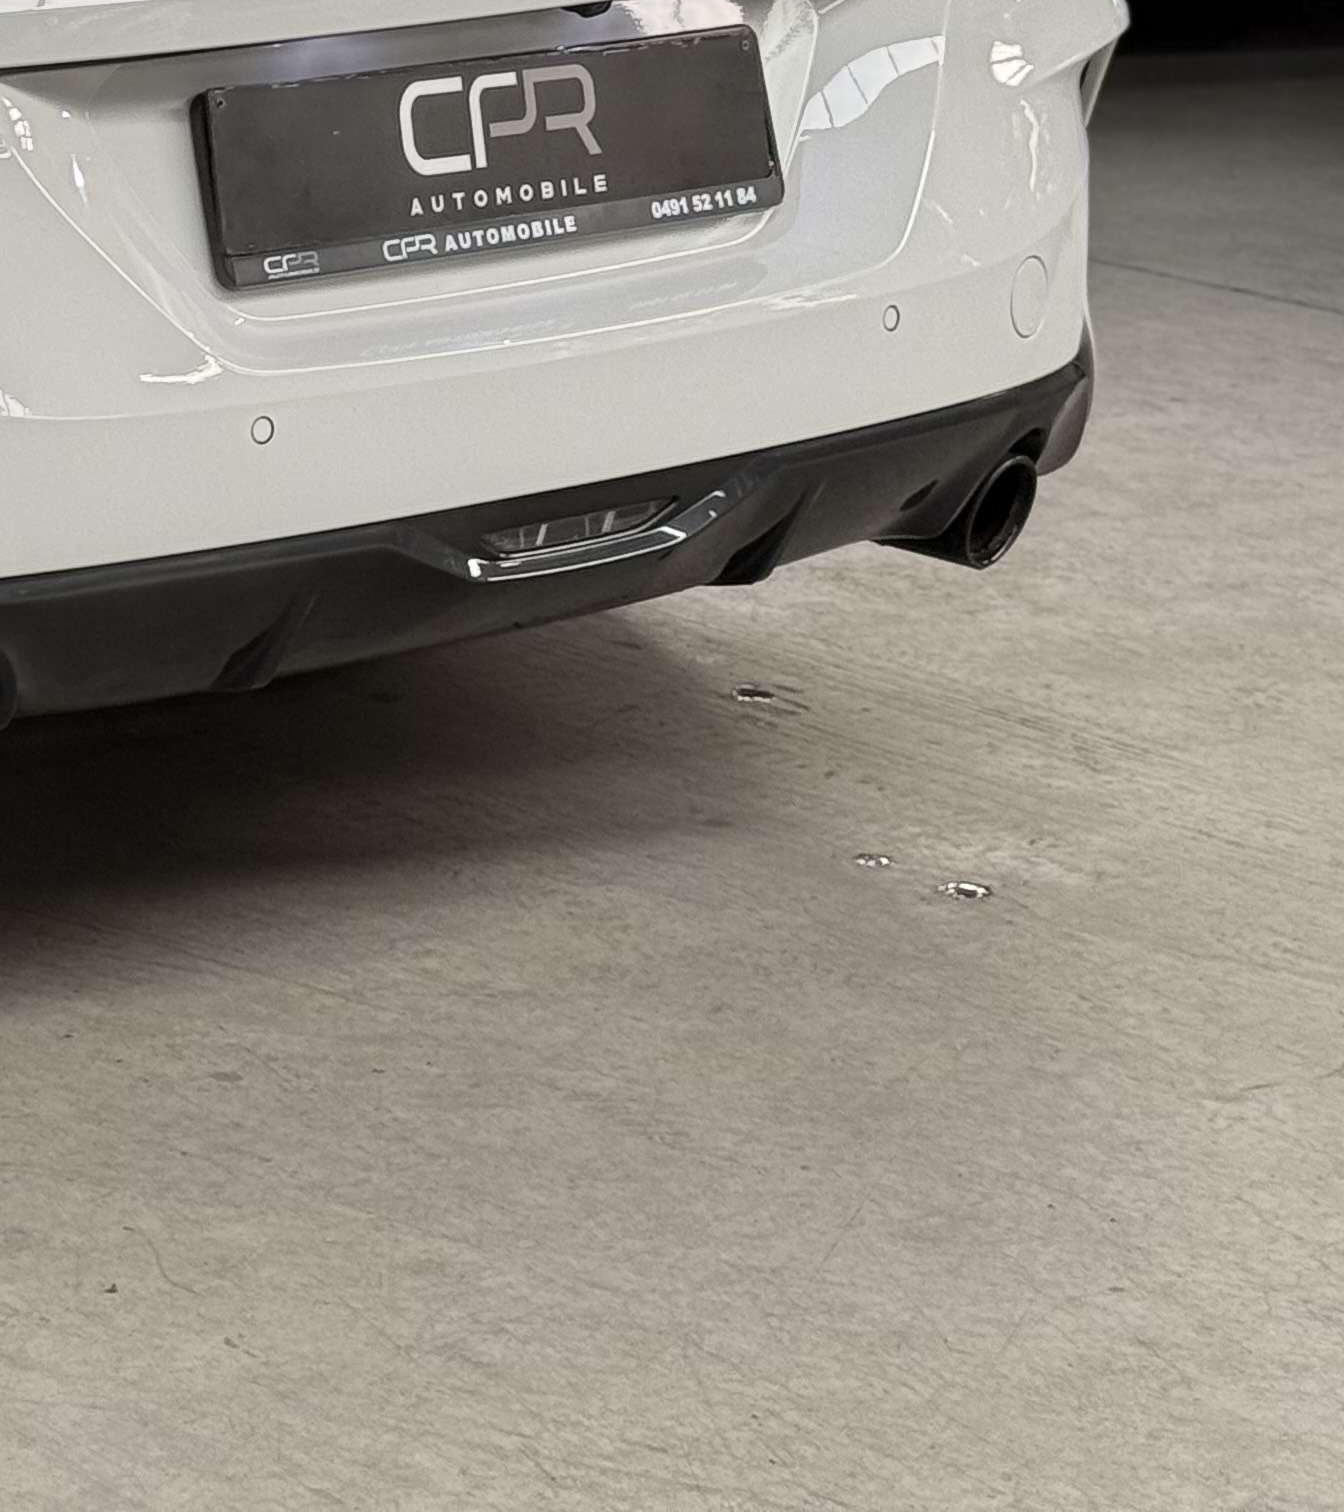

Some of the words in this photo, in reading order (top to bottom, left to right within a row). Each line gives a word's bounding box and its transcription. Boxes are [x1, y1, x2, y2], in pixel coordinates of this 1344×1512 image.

[399, 63, 602, 177] CPR
[410, 174, 609, 217] AUTOMOBILE
[651, 196, 689, 219] 0491
[692, 193, 713, 213] 52
[715, 189, 734, 209] 11
[736, 186, 757, 205] 84
[382, 233, 438, 262] CPR
[444, 215, 578, 252] AUTOMOBILE
[263, 251, 320, 274] CPR
